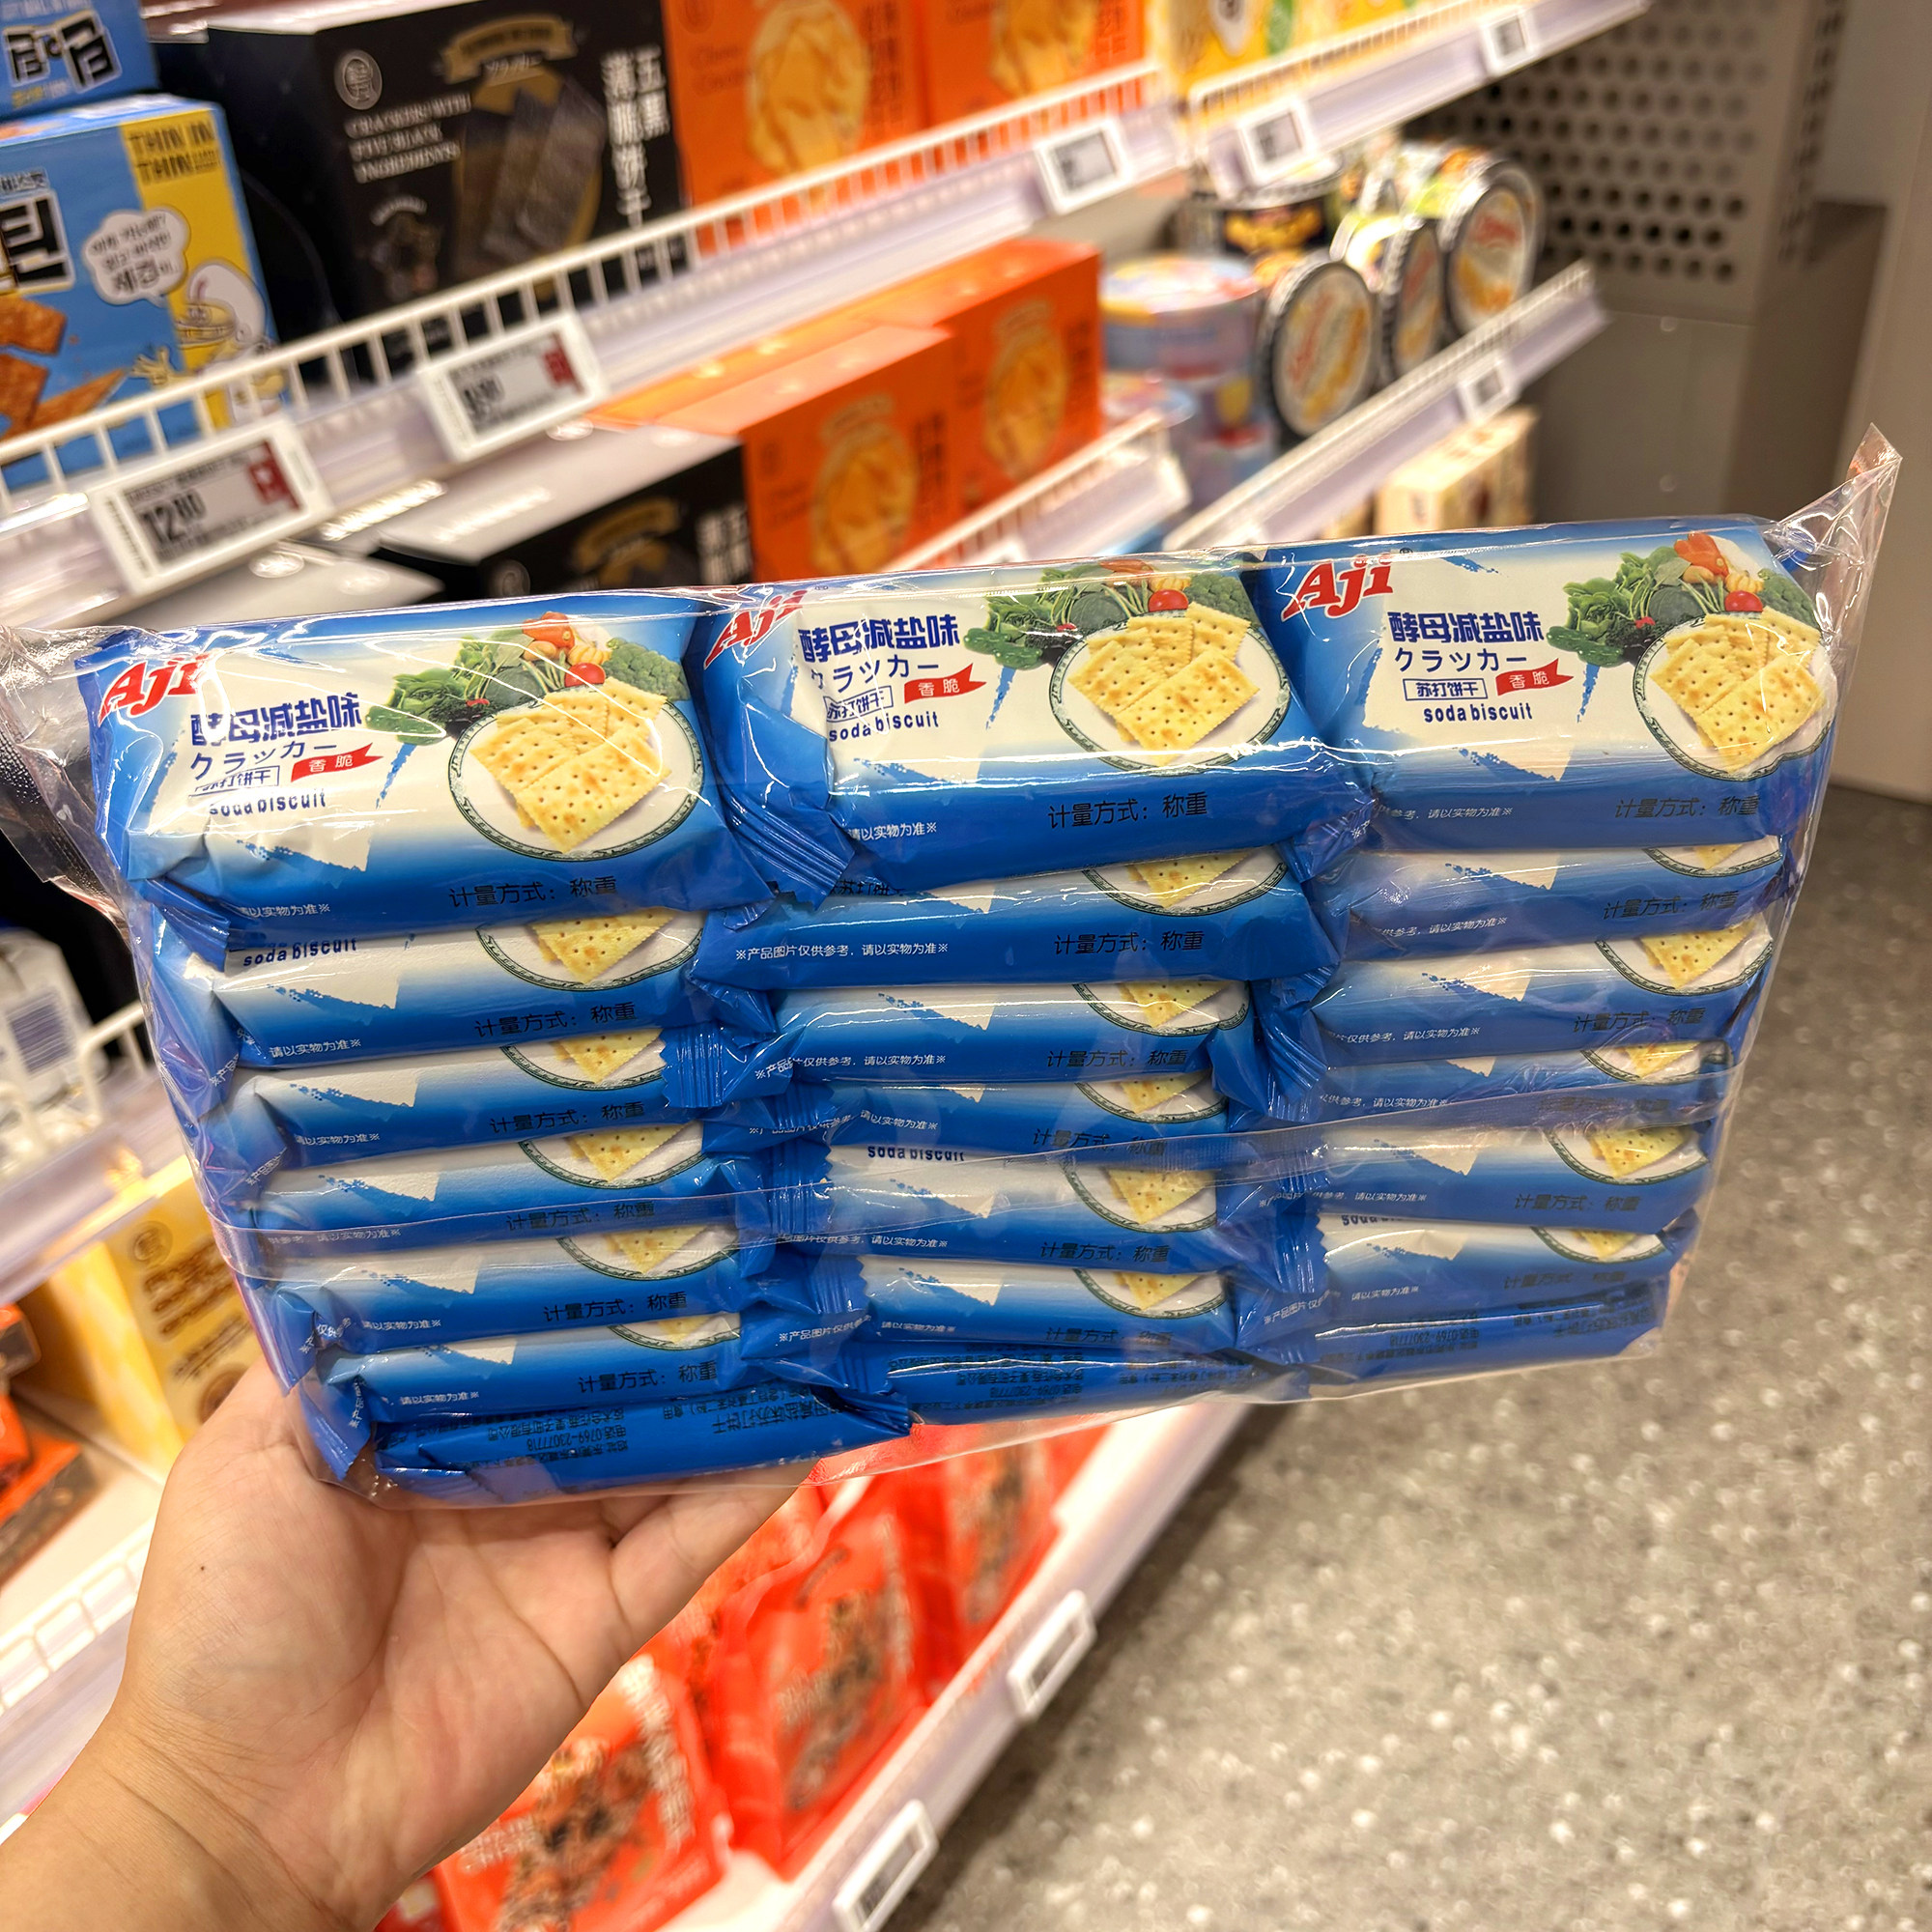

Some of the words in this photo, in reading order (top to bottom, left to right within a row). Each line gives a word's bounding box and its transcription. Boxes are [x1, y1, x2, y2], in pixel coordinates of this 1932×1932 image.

[128, 125, 185, 153] THIN
[190, 120, 215, 144] IN
[137, 154, 193, 185] THIN
[1281, 554, 1394, 621] Aji
[703, 589, 809, 669] Aji
[798, 613, 960, 664] 酵母减盐味
[1387, 611, 1545, 643] 酵母减盐味
[1395, 647, 1527, 672] クラッカー
[99, 653, 211, 727] Aji
[827, 691, 885, 720] 苏打饼干
[918, 678, 960, 696] 香脆
[1415, 681, 1479, 697] 苏打饼干
[1509, 671, 1550, 689] 香脆
[829, 723, 871, 742] soda
[874, 710, 939, 733] biscuit
[1423, 704, 1466, 723] soda
[1470, 702, 1533, 721] biscuit
[190, 741, 337, 781] クラッカー
[308, 754, 354, 773] 香脆
[1047, 791, 1208, 830] 计量方式：称重
[1614, 795, 1761, 819] 计量方式：称重
[448, 875, 618, 908] 计量方式：称重
[1603, 891, 1739, 921] 计量方式：称重
[243, 948, 288, 967] soda
[292, 937, 356, 960] biscuit
[1054, 930, 1206, 955] 计量方式：称重
[474, 1002, 638, 1038] 计量方式：称重
[269, 1038, 362, 1059] 请以实物为准※
[1047, 1050, 1188, 1068] 计量方式：称重
[490, 1101, 645, 1134] 计量方式：称重
[505, 1201, 656, 1232] 计量方式：称重
[1040, 1242, 1170, 1264] 计量方式：称重
[543, 1291, 688, 1322] 计量方式：称重
[579, 1360, 718, 1394] 计量方式：称重
